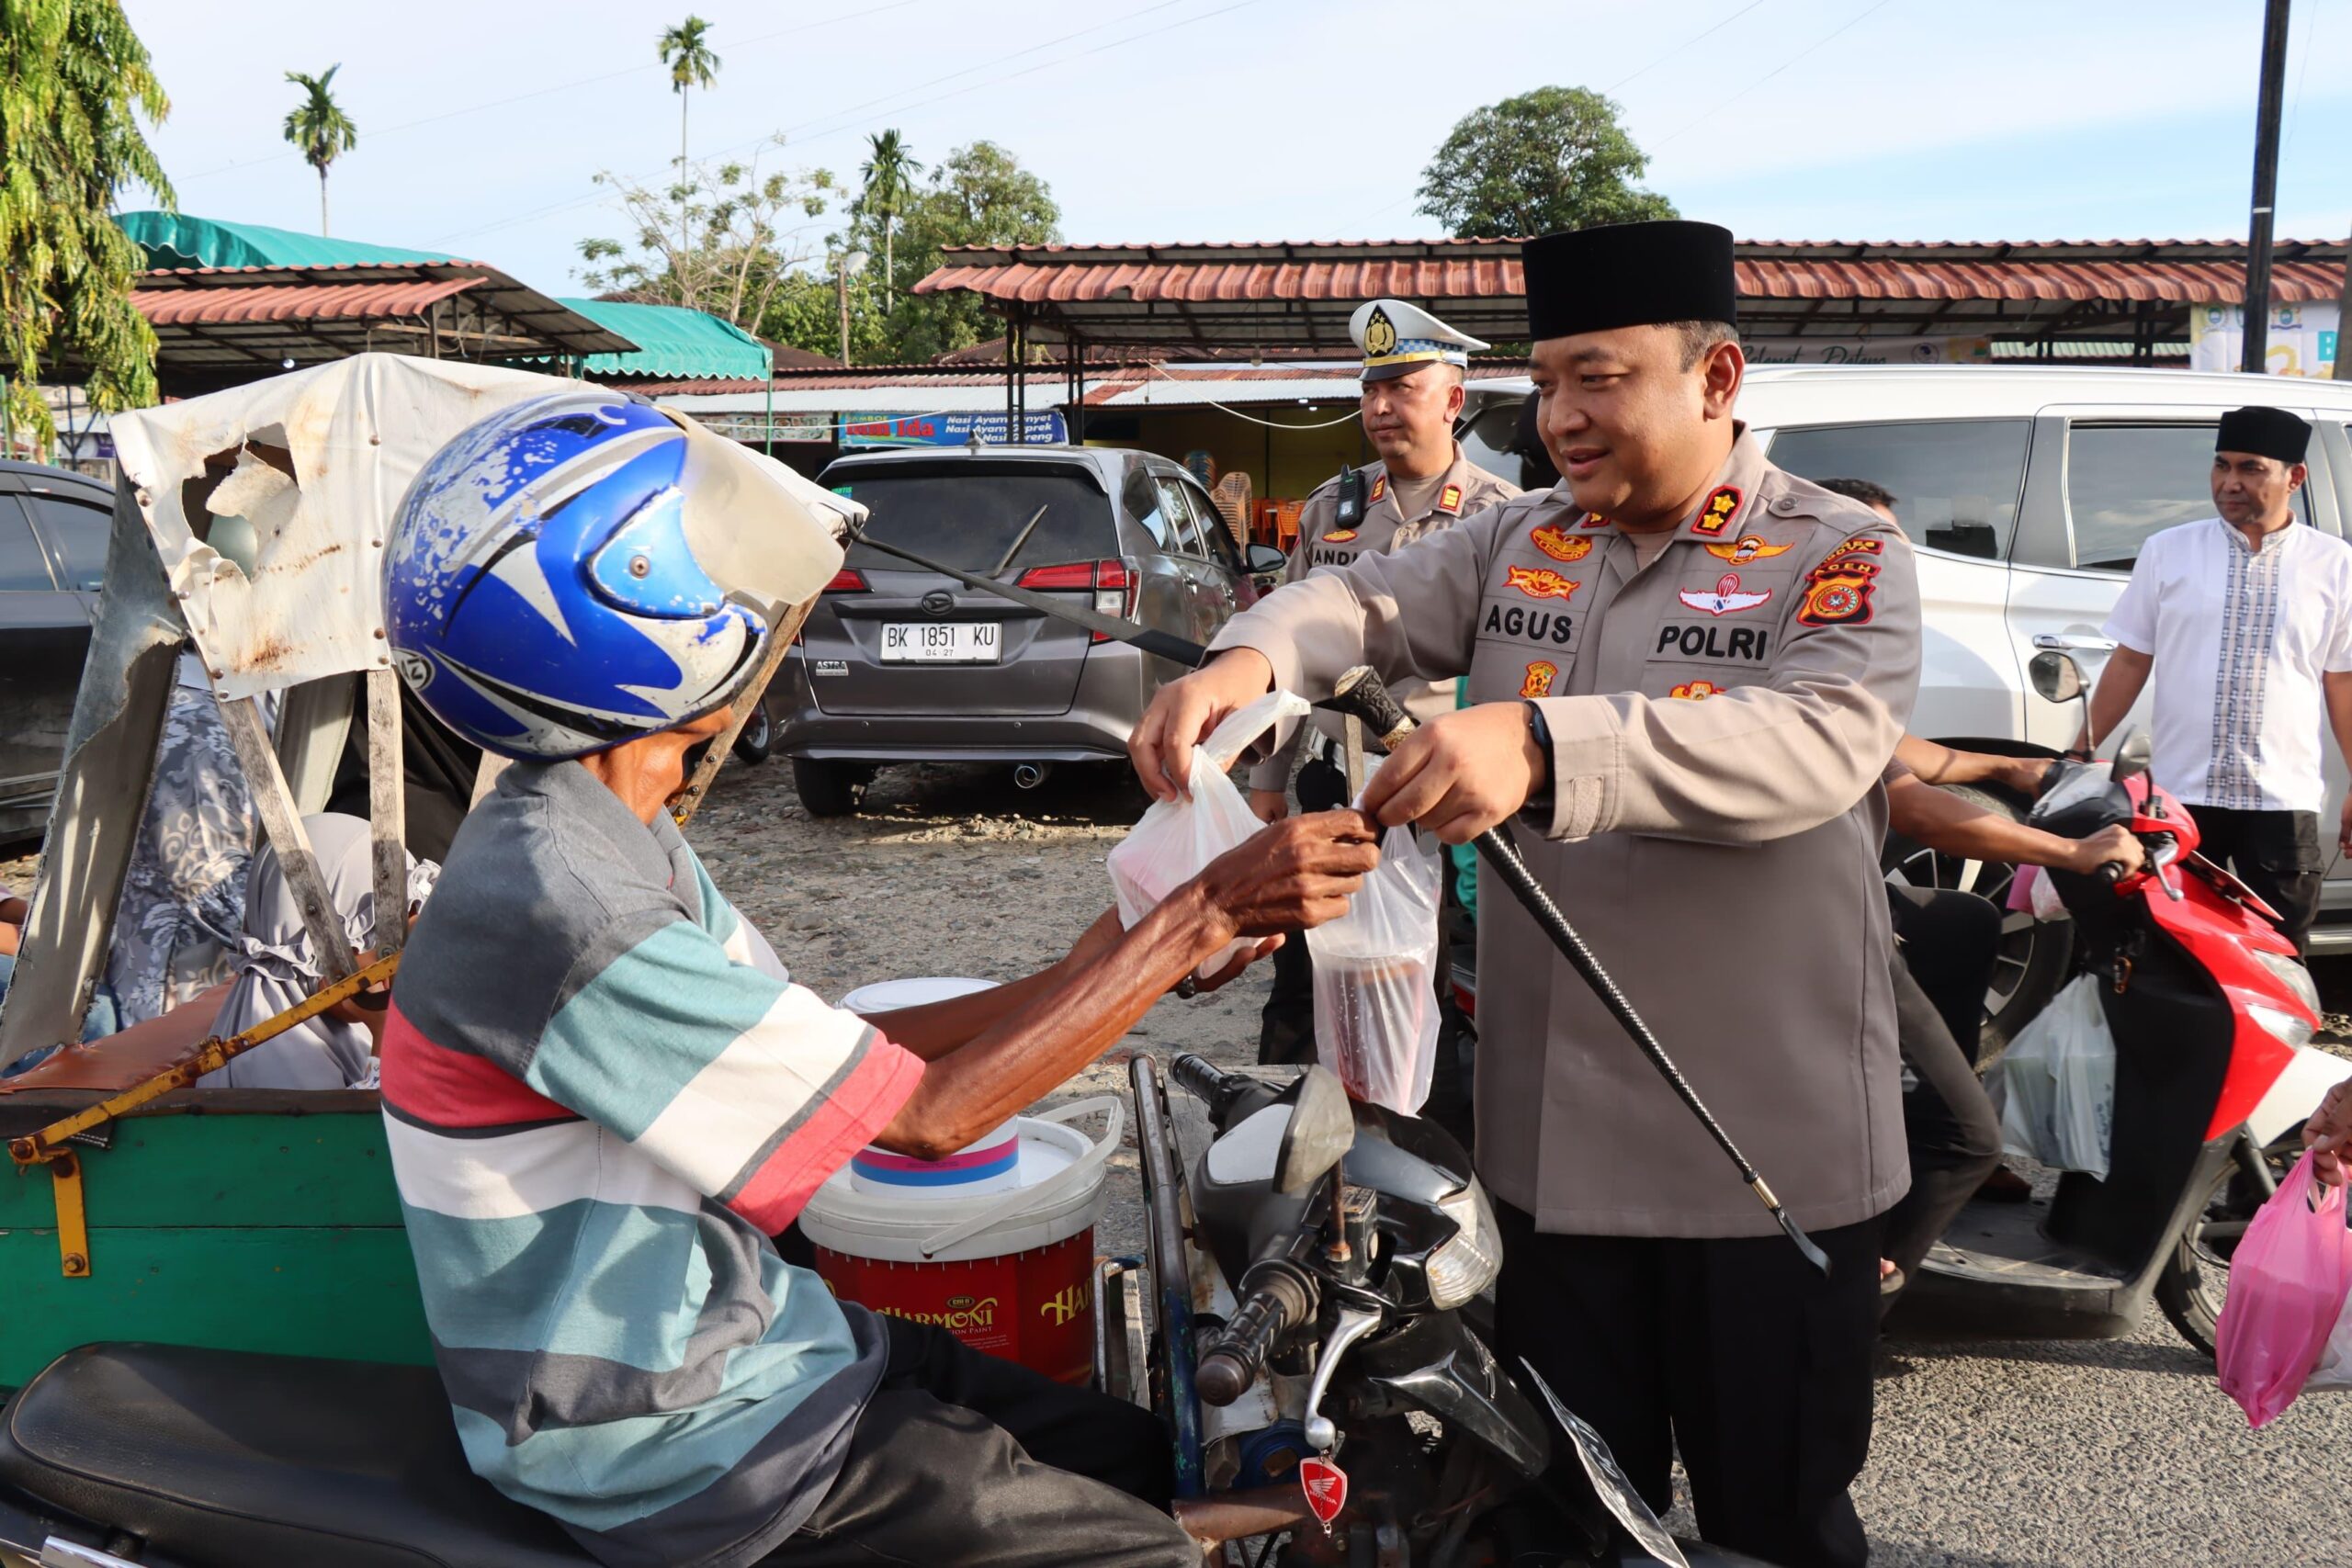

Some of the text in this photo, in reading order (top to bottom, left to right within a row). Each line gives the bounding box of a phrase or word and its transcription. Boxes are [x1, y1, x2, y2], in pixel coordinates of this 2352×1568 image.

[897, 418, 935, 437] Ida
[947, 415, 1051, 425] Nasi Ayam Pnyet
[973, 424, 1007, 435] Ayam
[1012, 423, 1052, 434] Gprek
[982, 434, 1053, 443] Nasi Greng
[1485, 604, 1572, 644] AGUS
[888, 626, 994, 648] BK 1851 KU
[1657, 626, 1768, 660] POLRI
[817, 660, 846, 670] ASTRA
